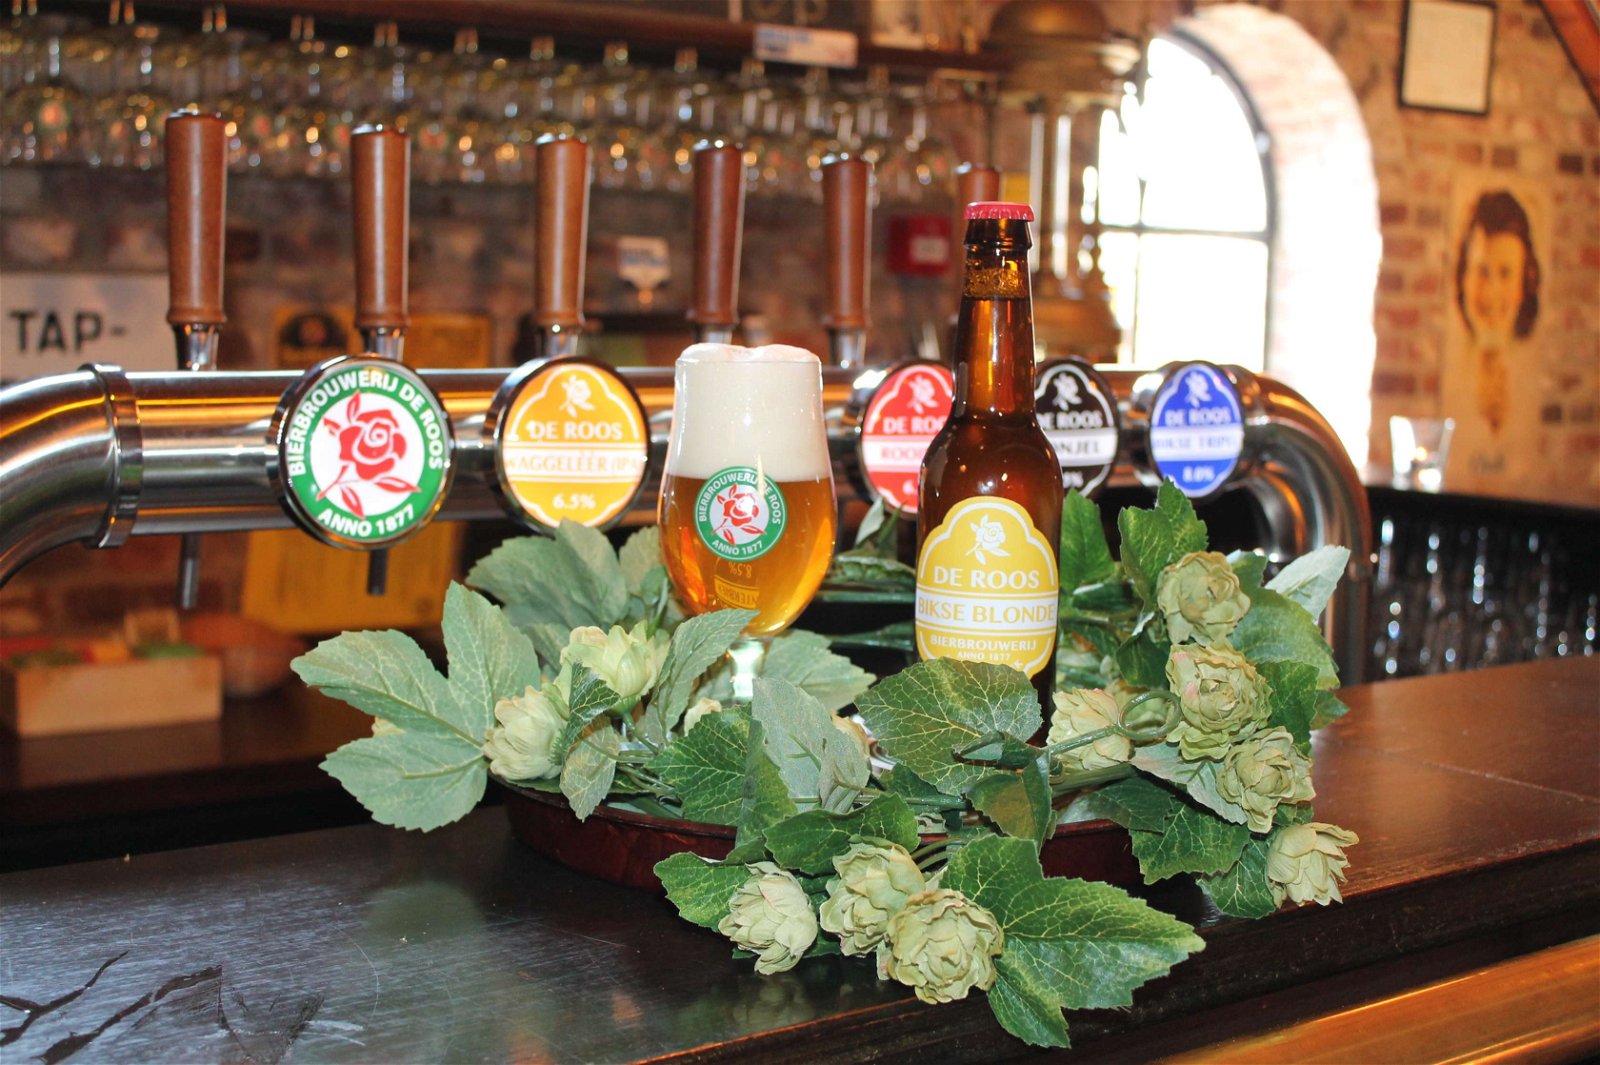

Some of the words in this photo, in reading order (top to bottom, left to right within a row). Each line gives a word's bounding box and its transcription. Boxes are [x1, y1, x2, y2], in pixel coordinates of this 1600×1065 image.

[288, 369, 399, 477] BIERBROUWERIJ
[399, 383, 426, 412] DE
[419, 405, 443, 469] ROOS
[530, 421, 559, 439] DE
[564, 421, 623, 440] ROOS
[883, 415, 908, 434] DE
[552, 493, 596, 510] 6.5%
[699, 472, 757, 522] BIERBROUWERIJ
[769, 495, 781, 525] ROOS
[316, 508, 372, 537] ANNO
[376, 503, 414, 535] 1877
[711, 540, 739, 556] ANNO
[742, 540, 763, 555] 1877
[933, 565, 964, 587] DE
[970, 569, 1041, 590] ROOS
[918, 594, 966, 622] BIKSE
[972, 602, 1055, 624] BLONDE
[930, 634, 1037, 651] BIERBROUWERIJ
